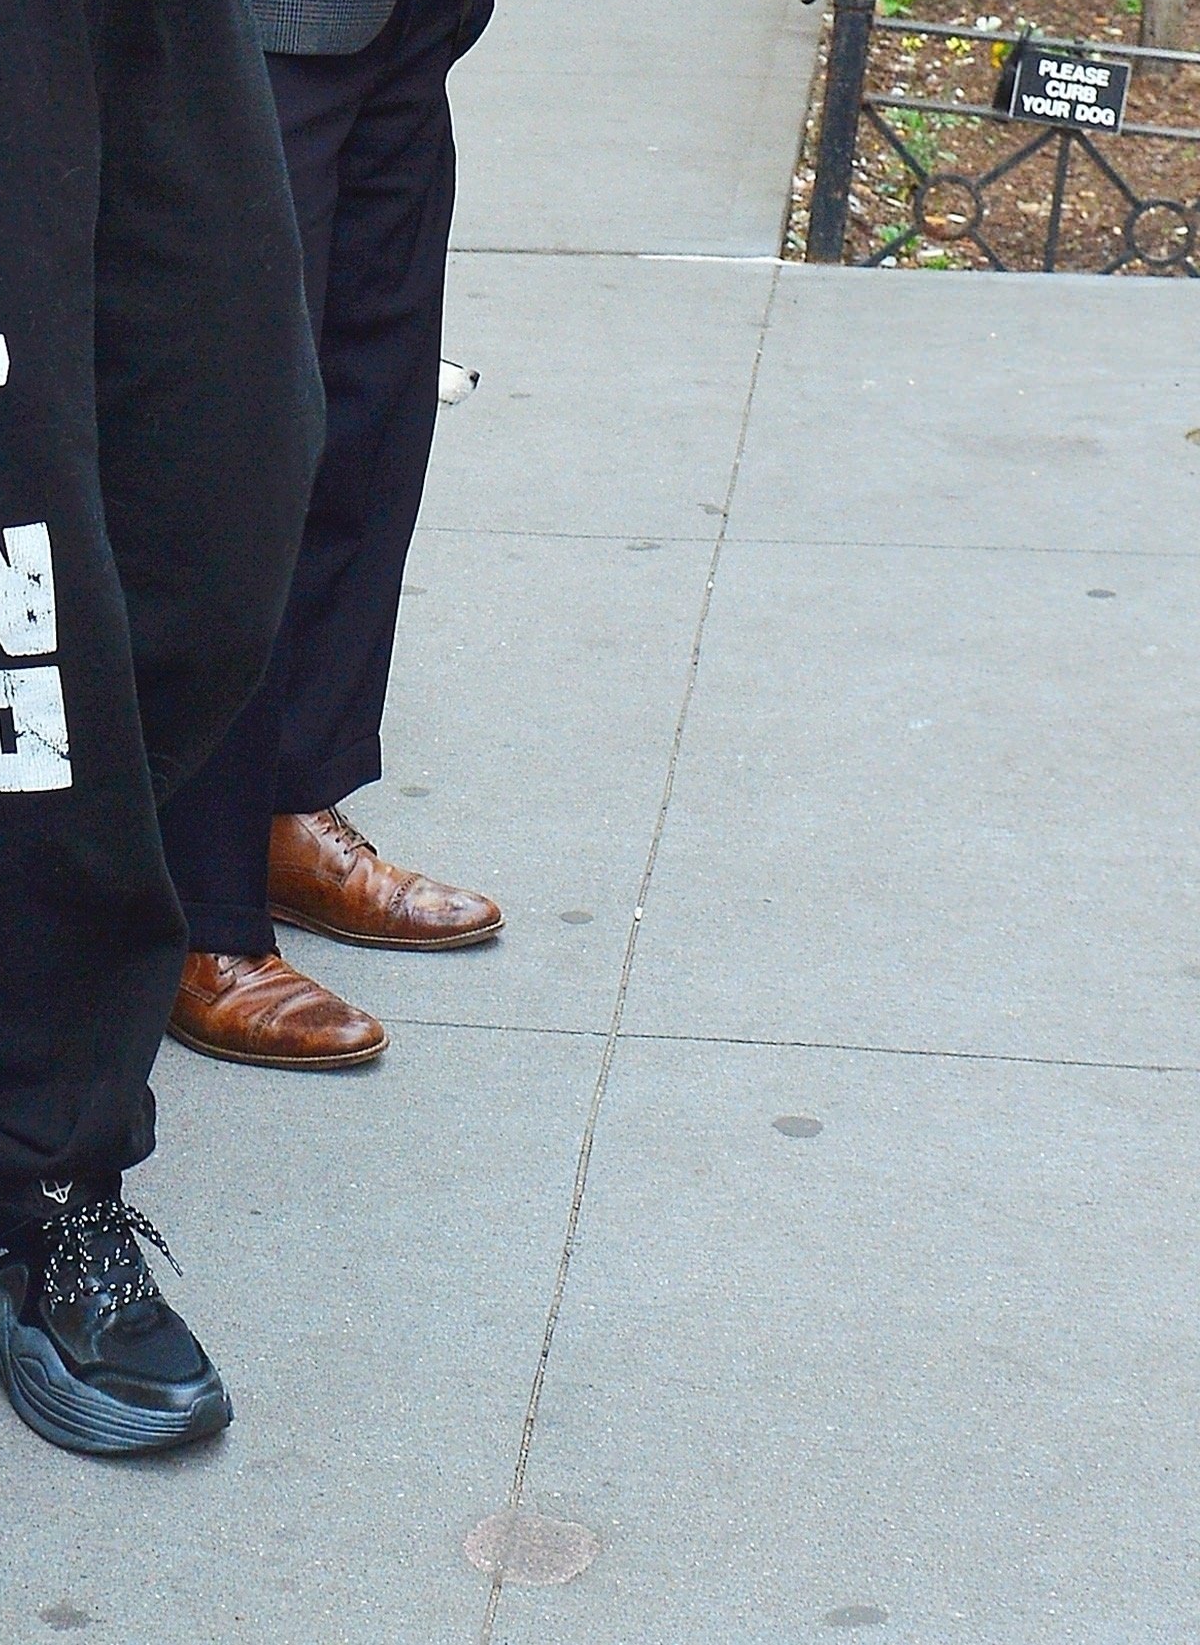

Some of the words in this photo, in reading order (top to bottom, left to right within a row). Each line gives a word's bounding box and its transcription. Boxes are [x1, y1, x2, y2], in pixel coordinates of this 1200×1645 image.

[1039, 59, 1111, 87] PLEASE
[1045, 79, 1098, 104] CURB
[1022, 94, 1071, 119] YOUR
[1074, 103, 1116, 126] DOG
